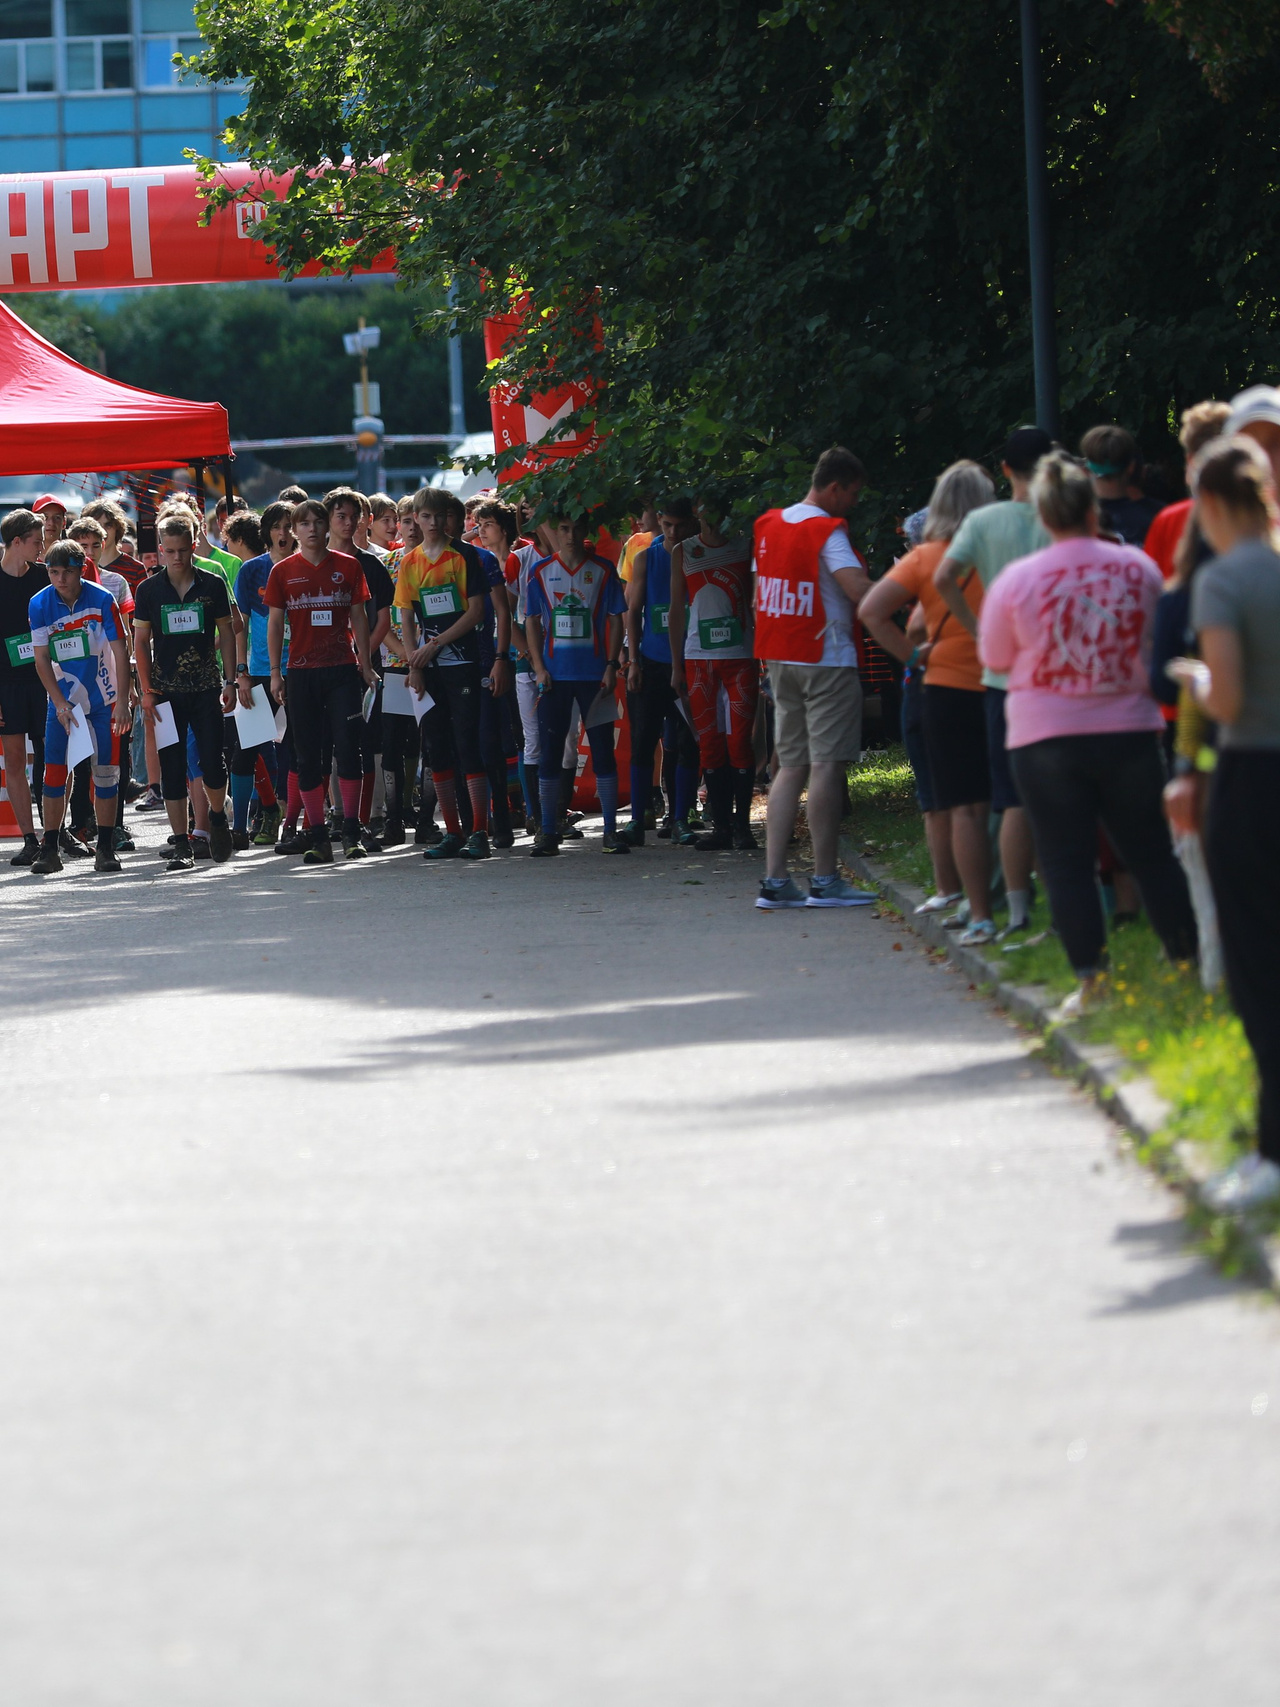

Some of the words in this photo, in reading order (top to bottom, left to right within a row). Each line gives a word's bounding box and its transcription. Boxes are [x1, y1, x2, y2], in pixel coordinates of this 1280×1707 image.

[713, 570, 730, 584] Run
[429, 595, 448, 604] 102.1
[173, 616, 192, 624] 104.1
[312, 613, 330, 621] 103.1
[59, 641, 77, 650] 105.1
[19, 646, 33, 654] 115.
